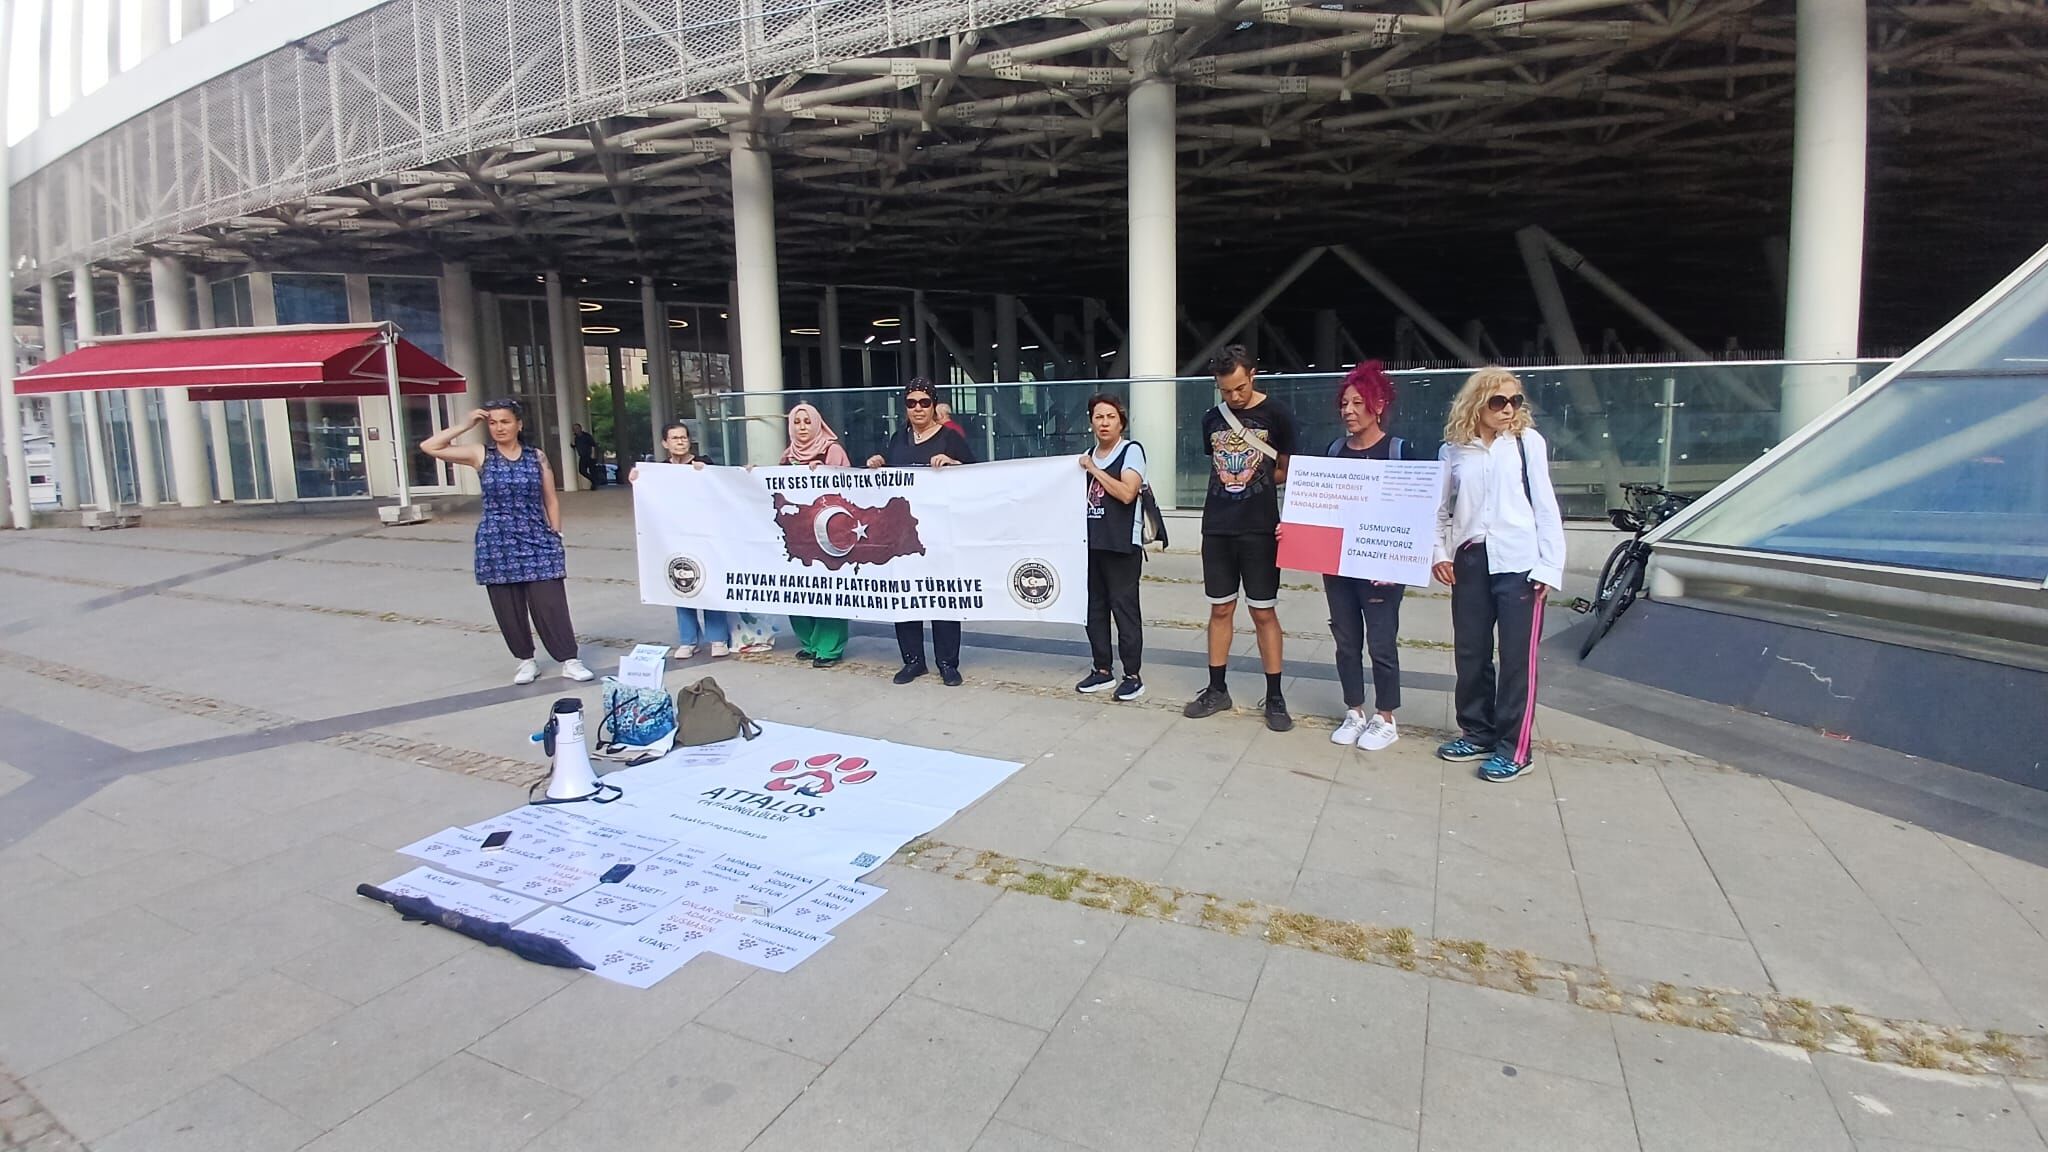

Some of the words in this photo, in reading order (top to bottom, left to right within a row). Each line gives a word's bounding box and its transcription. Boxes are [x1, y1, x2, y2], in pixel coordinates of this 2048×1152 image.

[766, 477, 785, 489] TEK
[788, 476, 808, 489] SES
[810, 475, 829, 488] TEK
[832, 472, 852, 490] GÜÇ
[854, 474, 873, 488] TEK
[875, 470, 915, 489] ÇÖZÜM
[1295, 469, 1309, 477] TÜM
[1310, 471, 1347, 480] HAYVANLAR
[1348, 472, 1370, 481] ÖZGÜR
[1291, 490, 1318, 498] HAYVAN
[1359, 523, 1411, 535] SUSMUYORUZ
[1355, 537, 1413, 549] KORKMUYORUZ
[726, 572, 776, 587] HAYVAN
[780, 574, 832, 589] HAKLARI
[836, 577, 911, 593] PLATFORMU
[915, 576, 982, 592] TÜRKİYE
[726, 588, 780, 603] ANTALYA
[783, 591, 832, 605] HAYVAN
[835, 594, 888, 610] HAKLARI
[891, 596, 983, 610] PLATFORMU
[701, 786, 825, 818] ATTALOS
